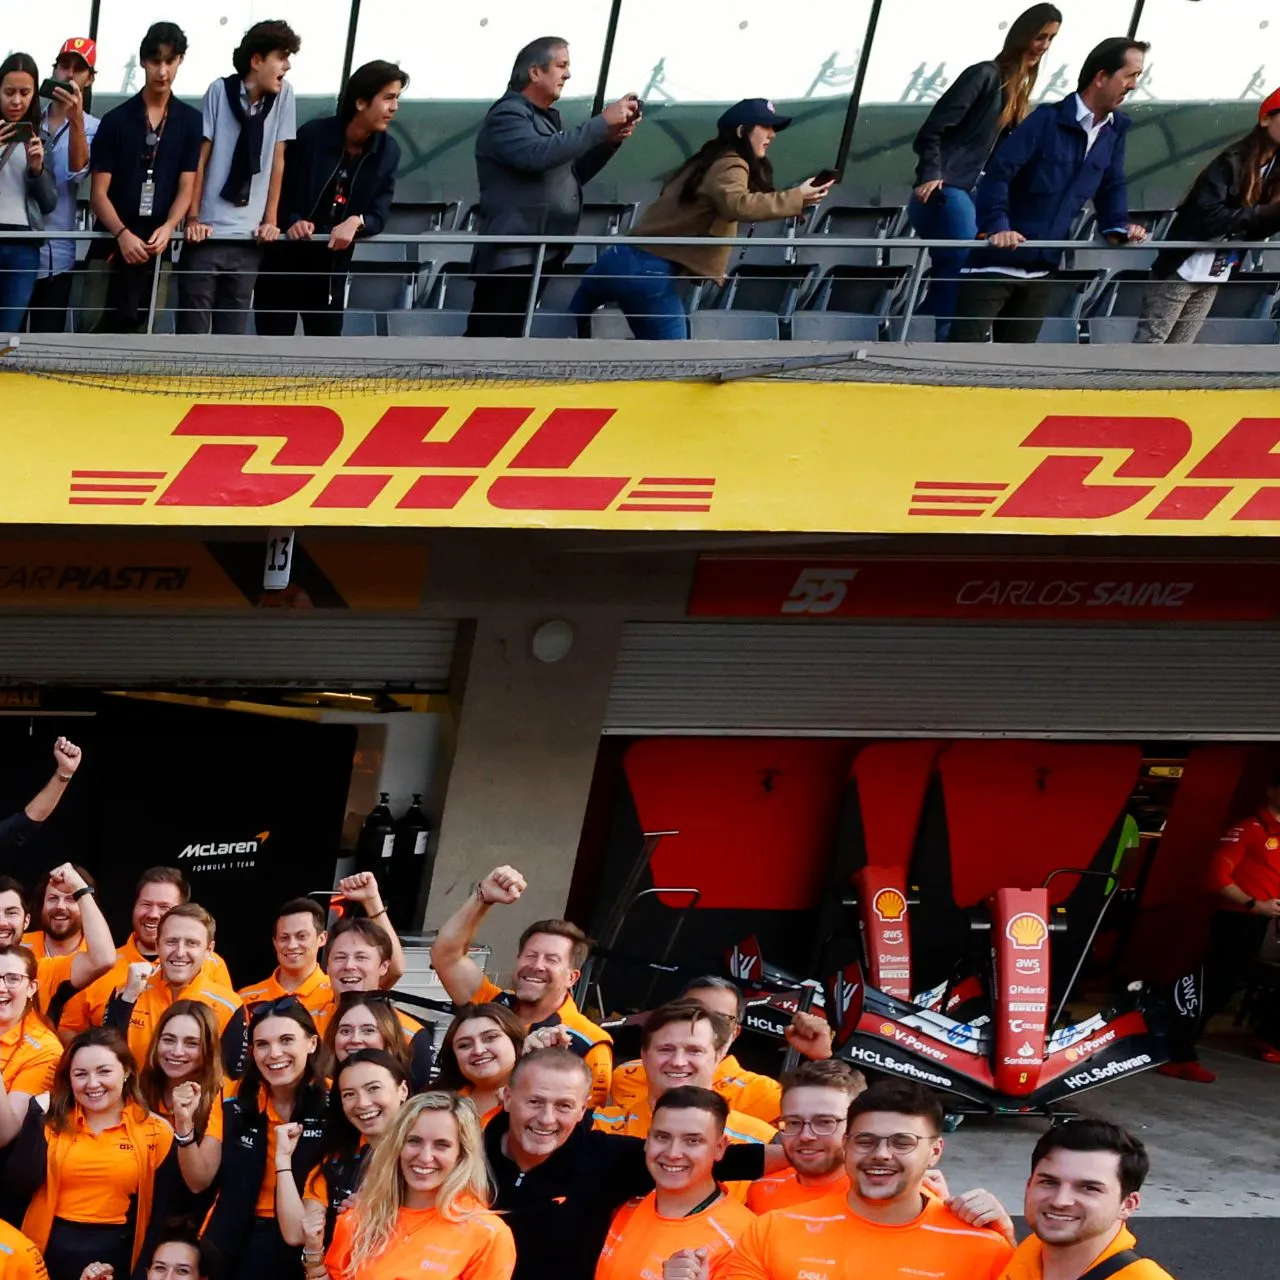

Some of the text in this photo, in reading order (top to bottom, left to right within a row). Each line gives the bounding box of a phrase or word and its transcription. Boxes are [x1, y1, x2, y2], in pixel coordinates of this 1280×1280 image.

[153, 403, 632, 511] DHL
[268, 537, 290, 572] 13
[53, 566, 191, 592] PIASTRI
[780, 568, 861, 614] 55
[955, 581, 1195, 607] CARLOS SAINZ
[177, 840, 258, 859] McLaren
[193, 862, 227, 871] FORMULA
[237, 861, 255, 869] TEAM
[1016, 958, 1040, 968] aws
[896, 1031, 948, 1061] V-Power
[1078, 1029, 1116, 1056] V-Power
[851, 1046, 952, 1088] HCLSoftware
[1004, 1057, 1042, 1065] Santander
[1065, 1053, 1152, 1090] HCLSoftware
